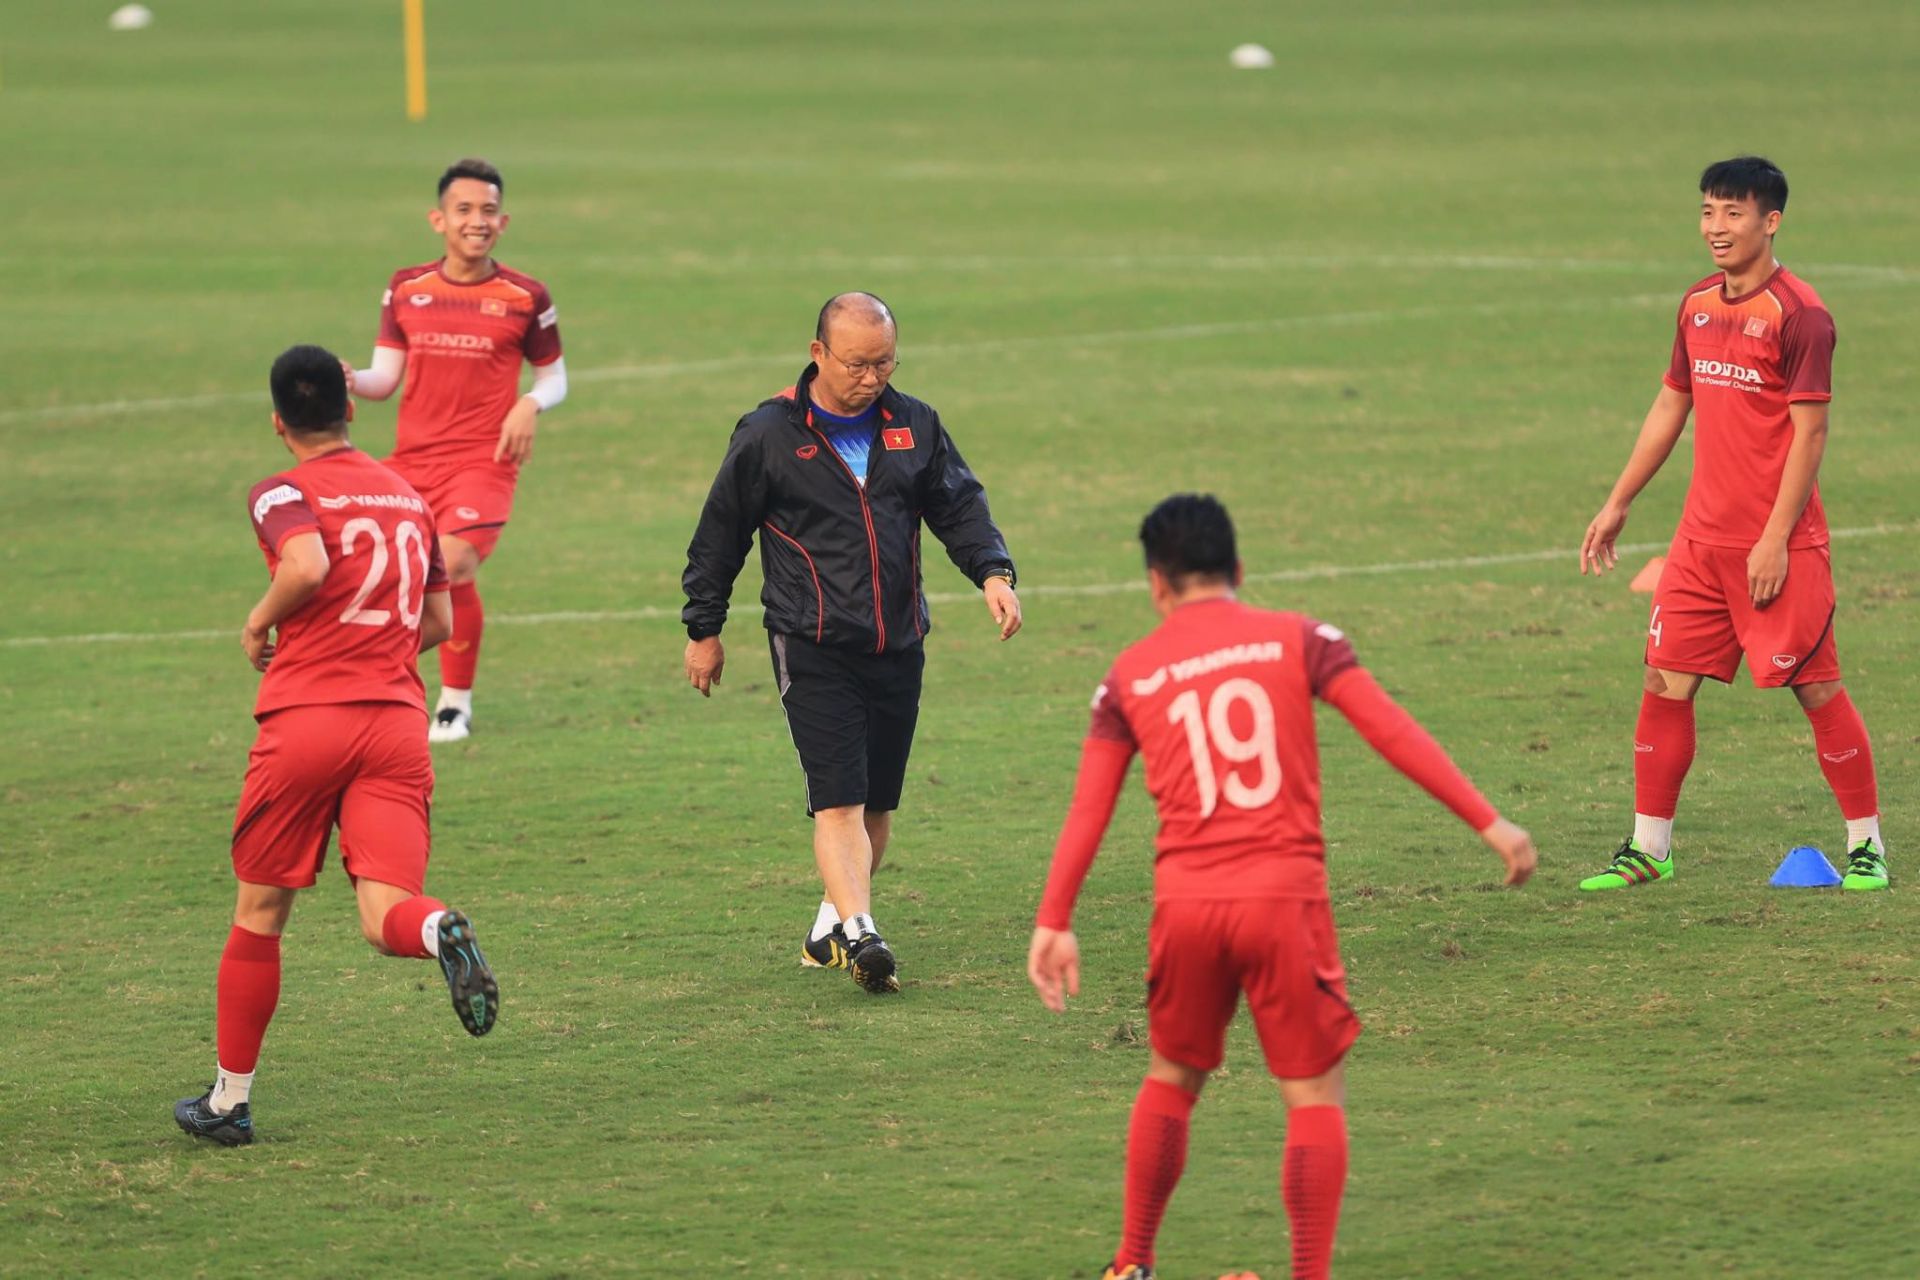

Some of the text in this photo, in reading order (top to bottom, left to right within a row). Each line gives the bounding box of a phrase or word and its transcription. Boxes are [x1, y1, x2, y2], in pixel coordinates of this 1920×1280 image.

[1693, 359, 1765, 384] HONDA
[351, 494, 424, 514] YANMAR
[340, 517, 428, 630] 20
[1168, 641, 1283, 683] YANMAR
[1167, 677, 1282, 818] 19
